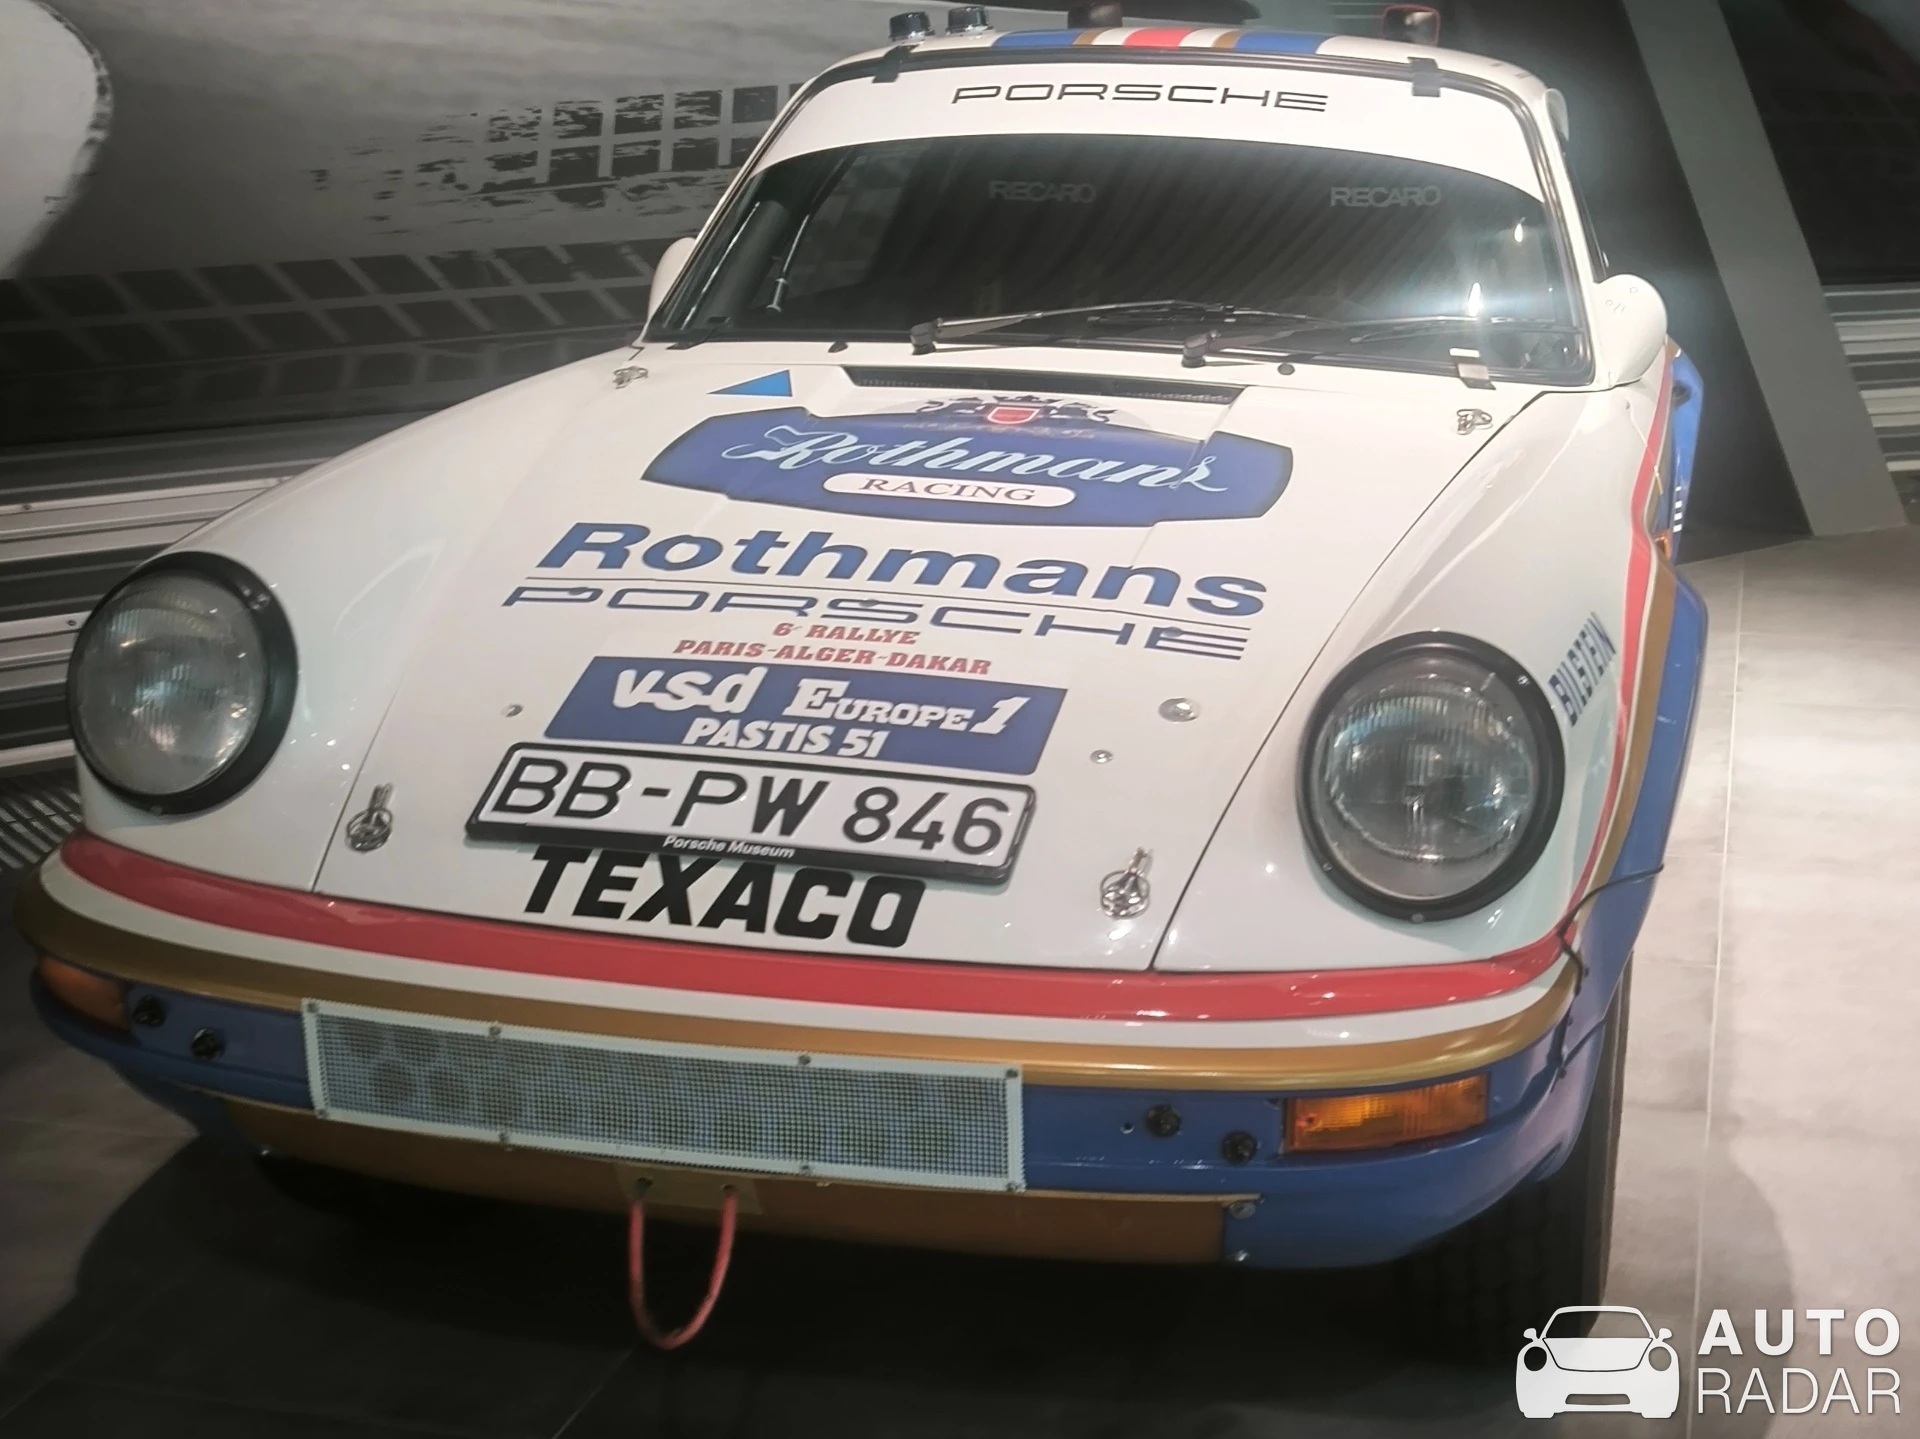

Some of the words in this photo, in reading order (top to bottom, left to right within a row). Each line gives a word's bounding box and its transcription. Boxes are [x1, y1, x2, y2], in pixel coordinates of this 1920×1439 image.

[951, 83, 1329, 113] PORSCHE
[989, 180, 1098, 203] RECARO
[1329, 185, 1442, 208] RECARO
[721, 424, 1228, 493] Rothmans
[861, 477, 1036, 502] RACING
[536, 522, 1268, 616] Rothmans
[501, 586, 1249, 661] PORSCHE
[805, 624, 920, 645] RALLYE
[673, 639, 992, 675] PARIS-ALGER-DAKAR
[1548, 610, 1616, 727] BILSTEIN
[682, 717, 836, 754] PASTIS
[836, 729, 890, 758] 51
[841, 785, 1012, 856] 846
[662, 834, 727, 852] Porsche
[726, 840, 796, 859] Museum
[523, 846, 926, 948] TEXACO
